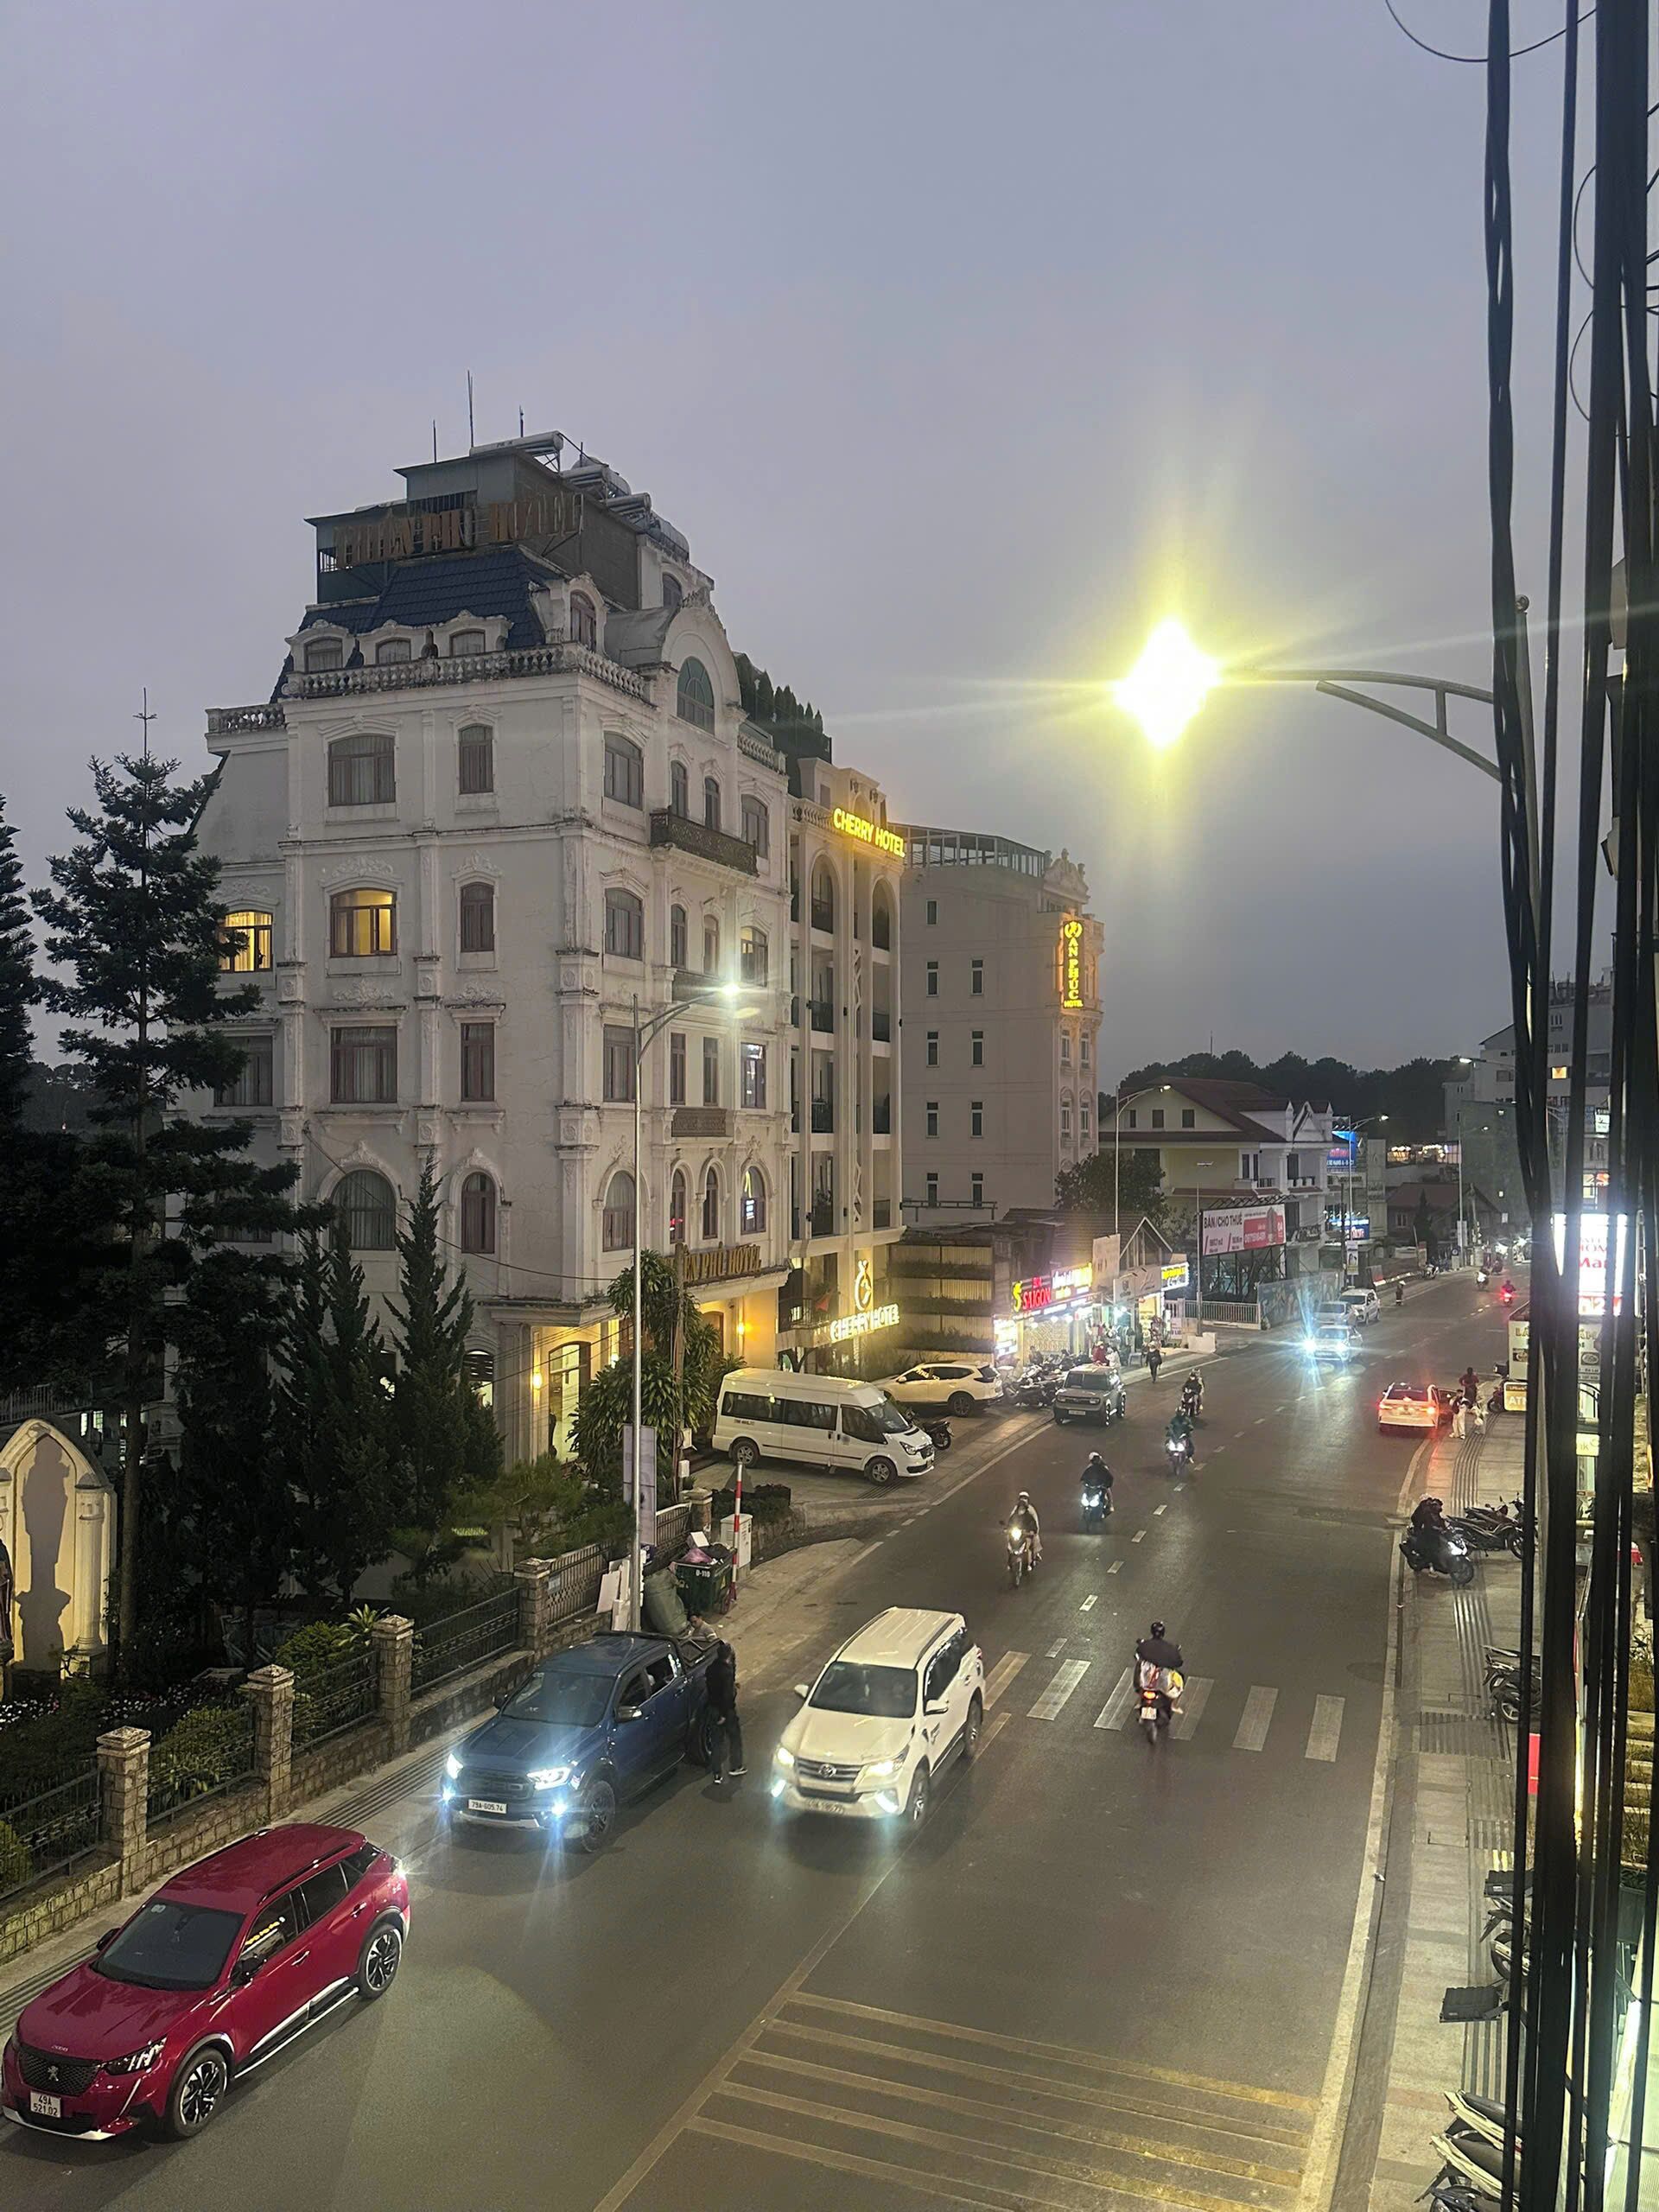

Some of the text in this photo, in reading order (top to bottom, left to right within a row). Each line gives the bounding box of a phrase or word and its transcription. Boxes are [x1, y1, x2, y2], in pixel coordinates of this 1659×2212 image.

[833, 807, 906, 858] CHERRY HOTEL
[728, 1245, 762, 1275] HOTEL
[1022, 1287, 1052, 1309] SAIGON
[830, 1303, 900, 1344] CHERRY HOTEL
[39, 2094, 52, 2106] 49A
